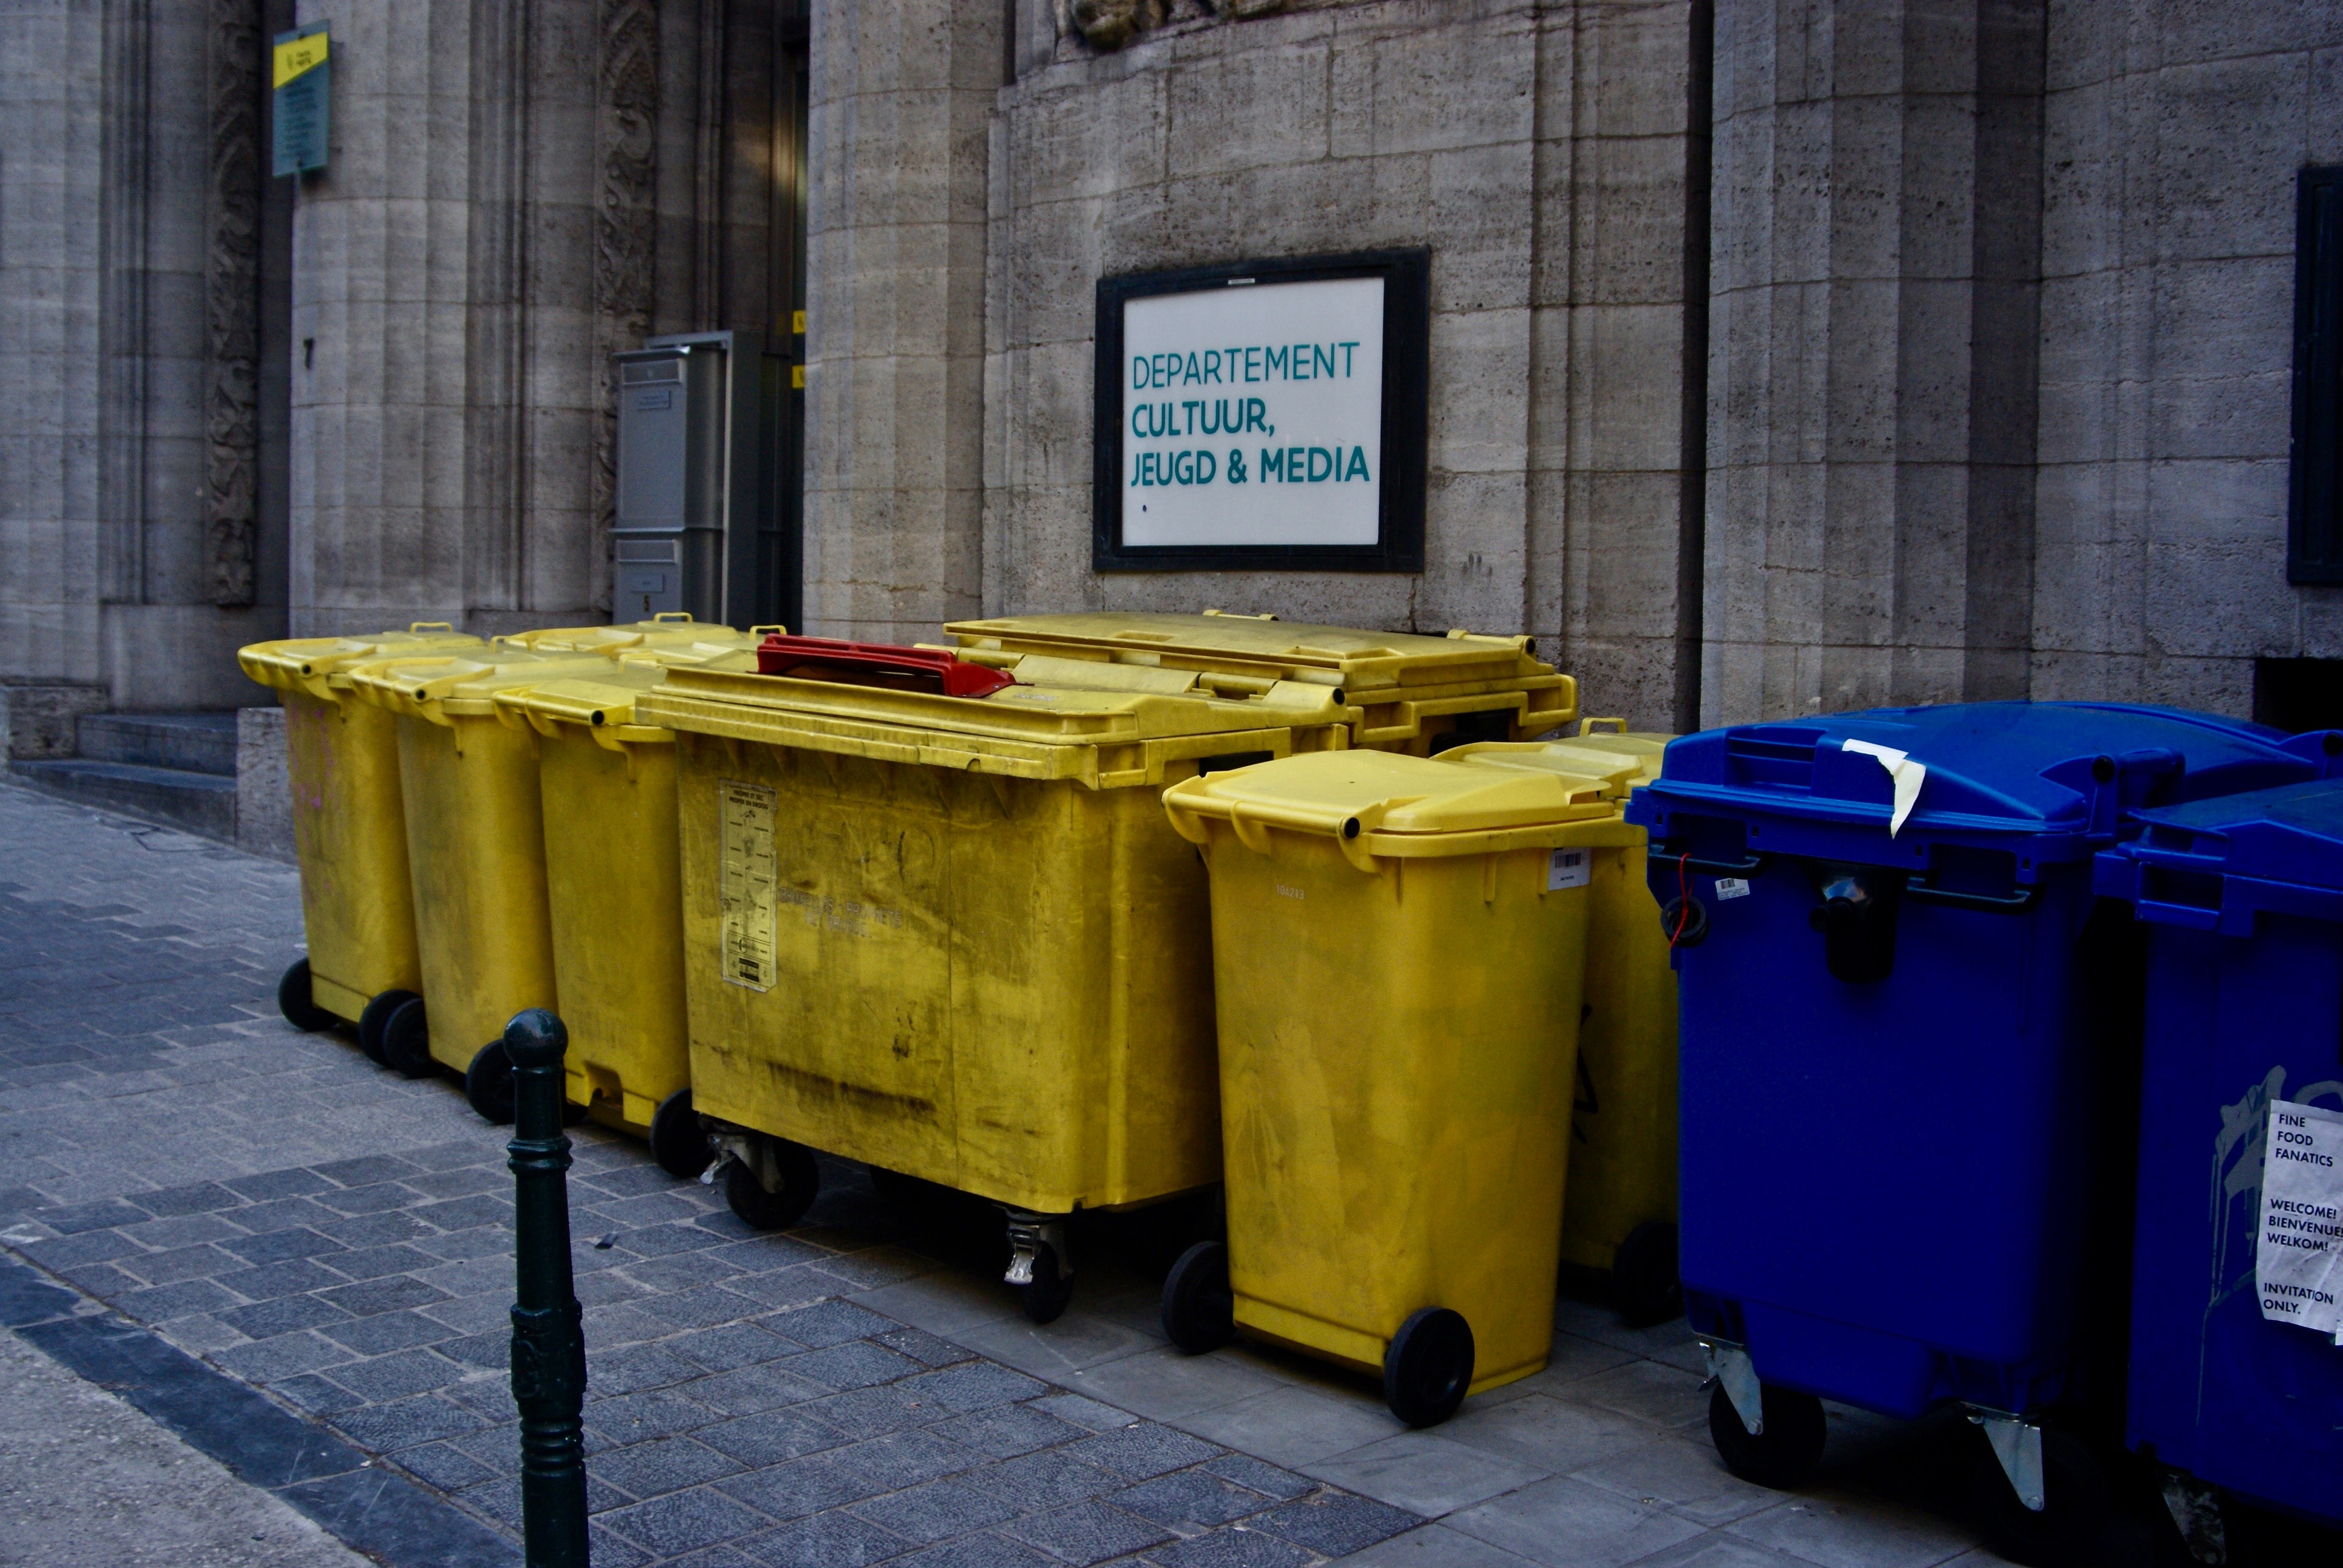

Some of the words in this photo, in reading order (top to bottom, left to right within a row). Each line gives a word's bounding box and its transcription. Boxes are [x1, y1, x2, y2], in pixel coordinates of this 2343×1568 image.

[1133, 342, 1360, 390] DEPARTEMENT
[1132, 397, 1275, 437] CULTUUR,
[1131, 450, 1216, 486] JEUGD
[1227, 448, 1247, 483] &
[1260, 446, 1370, 483] MEDIA
[2279, 1114, 2305, 1128] FINE
[2277, 1131, 2313, 1146] FOOD
[2275, 1148, 2333, 1166] FANATICS
[2270, 1198, 2337, 1220] WELCOME!
[2267, 1233, 2328, 1252] WELKOM!
[2264, 1282, 2334, 1305] INVITATION
[2263, 1298, 2301, 1315] ONLY.
